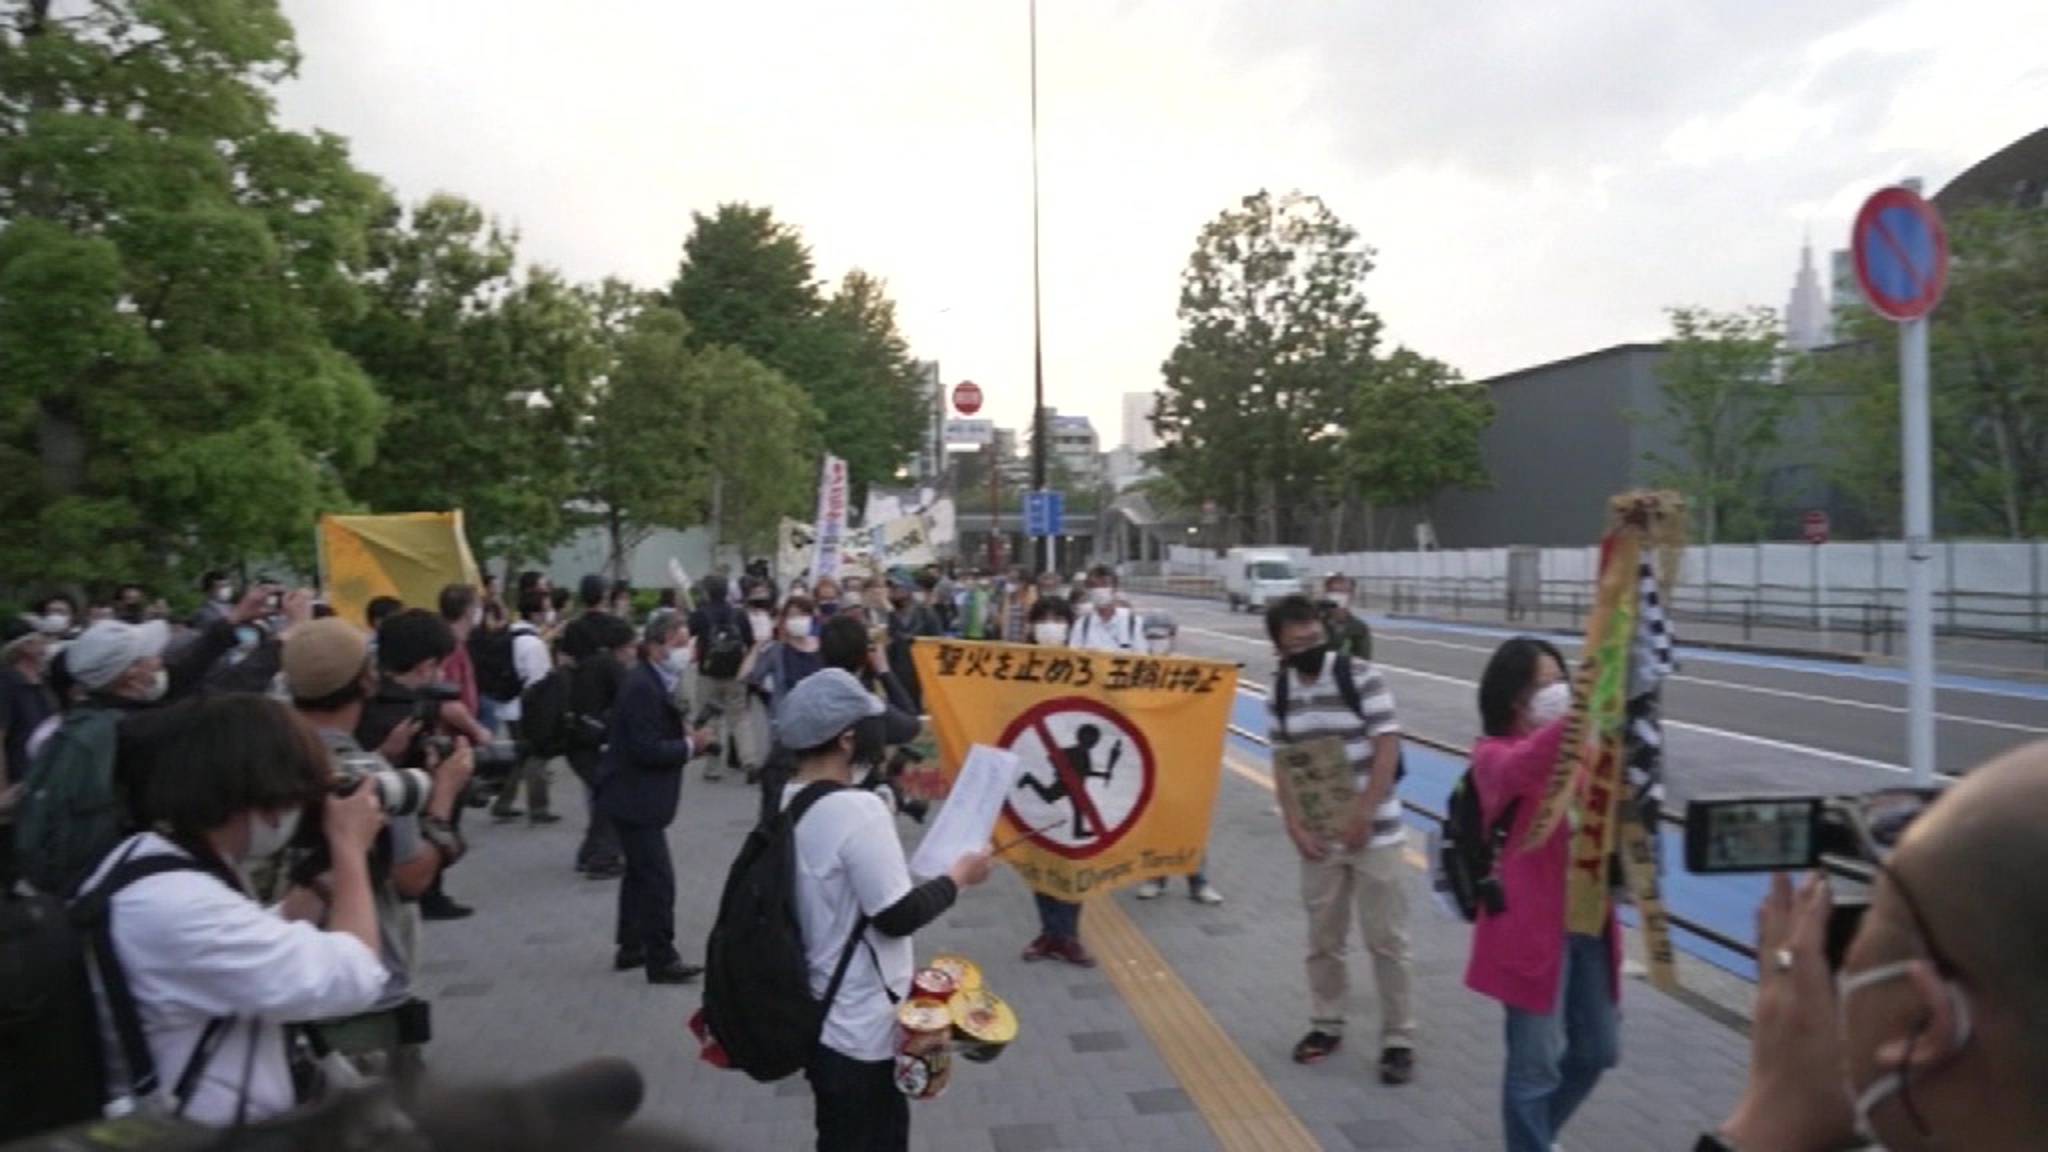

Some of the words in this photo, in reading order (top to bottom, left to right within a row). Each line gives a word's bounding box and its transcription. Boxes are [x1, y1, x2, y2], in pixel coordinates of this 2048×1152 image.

[934, 643, 1094, 687] 聖火を止めろ
[1102, 656, 1223, 694] 五輪は中止
